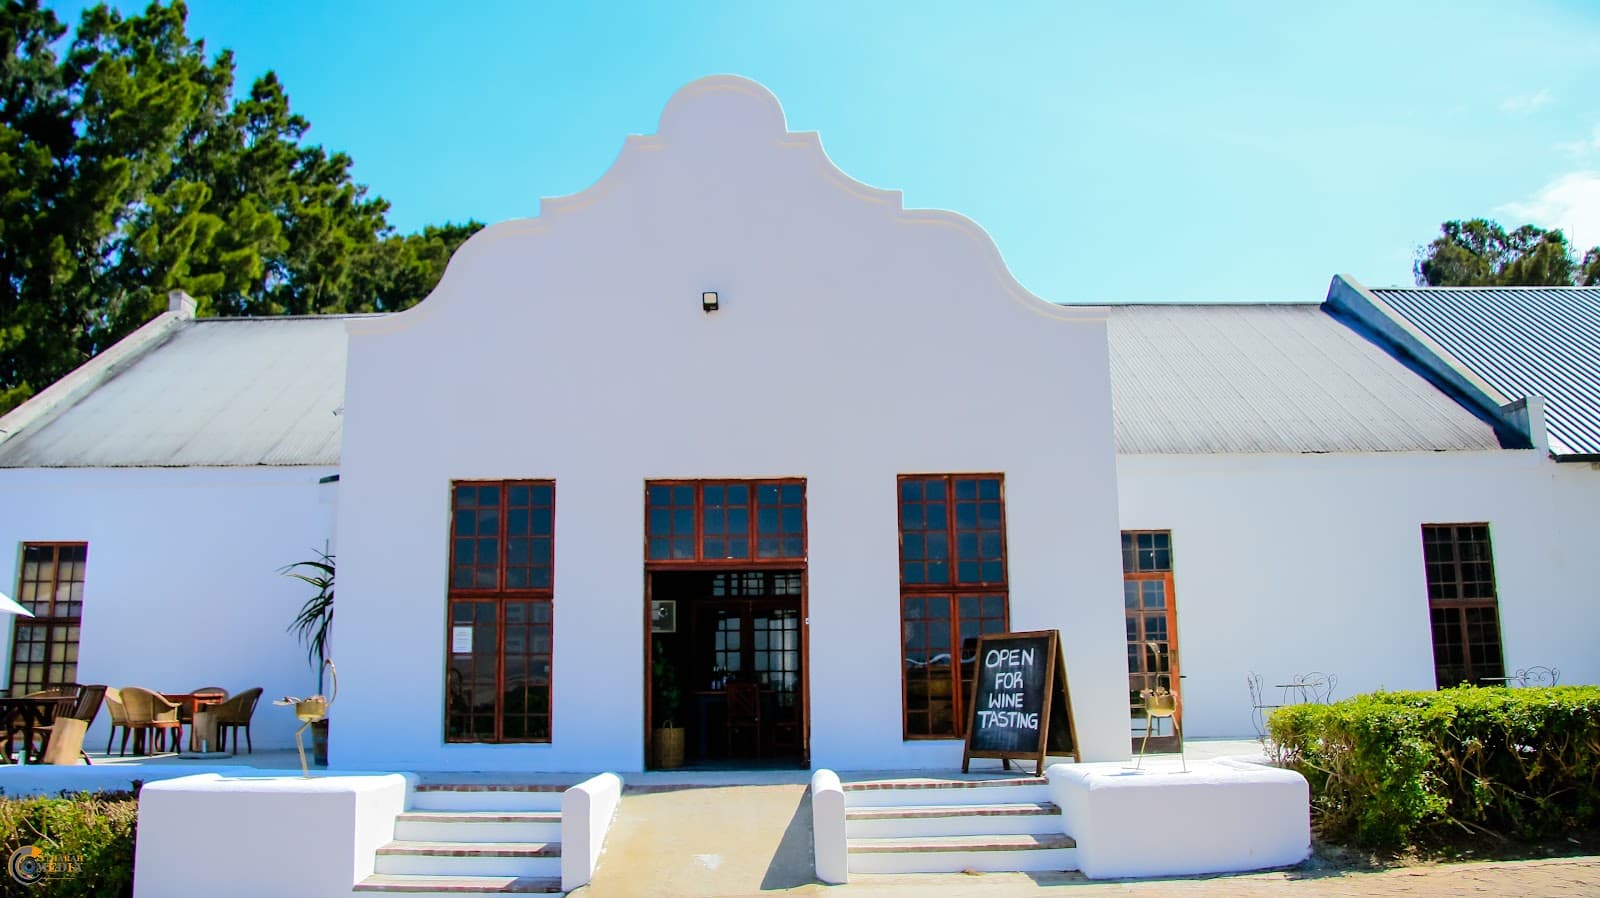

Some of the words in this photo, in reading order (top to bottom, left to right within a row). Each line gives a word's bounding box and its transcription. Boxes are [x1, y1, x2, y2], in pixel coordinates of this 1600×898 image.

[985, 647, 1035, 668] OPEN
[995, 671, 1024, 690] FOR
[988, 692, 1025, 709] WINE
[977, 710, 1039, 730] TASTING
